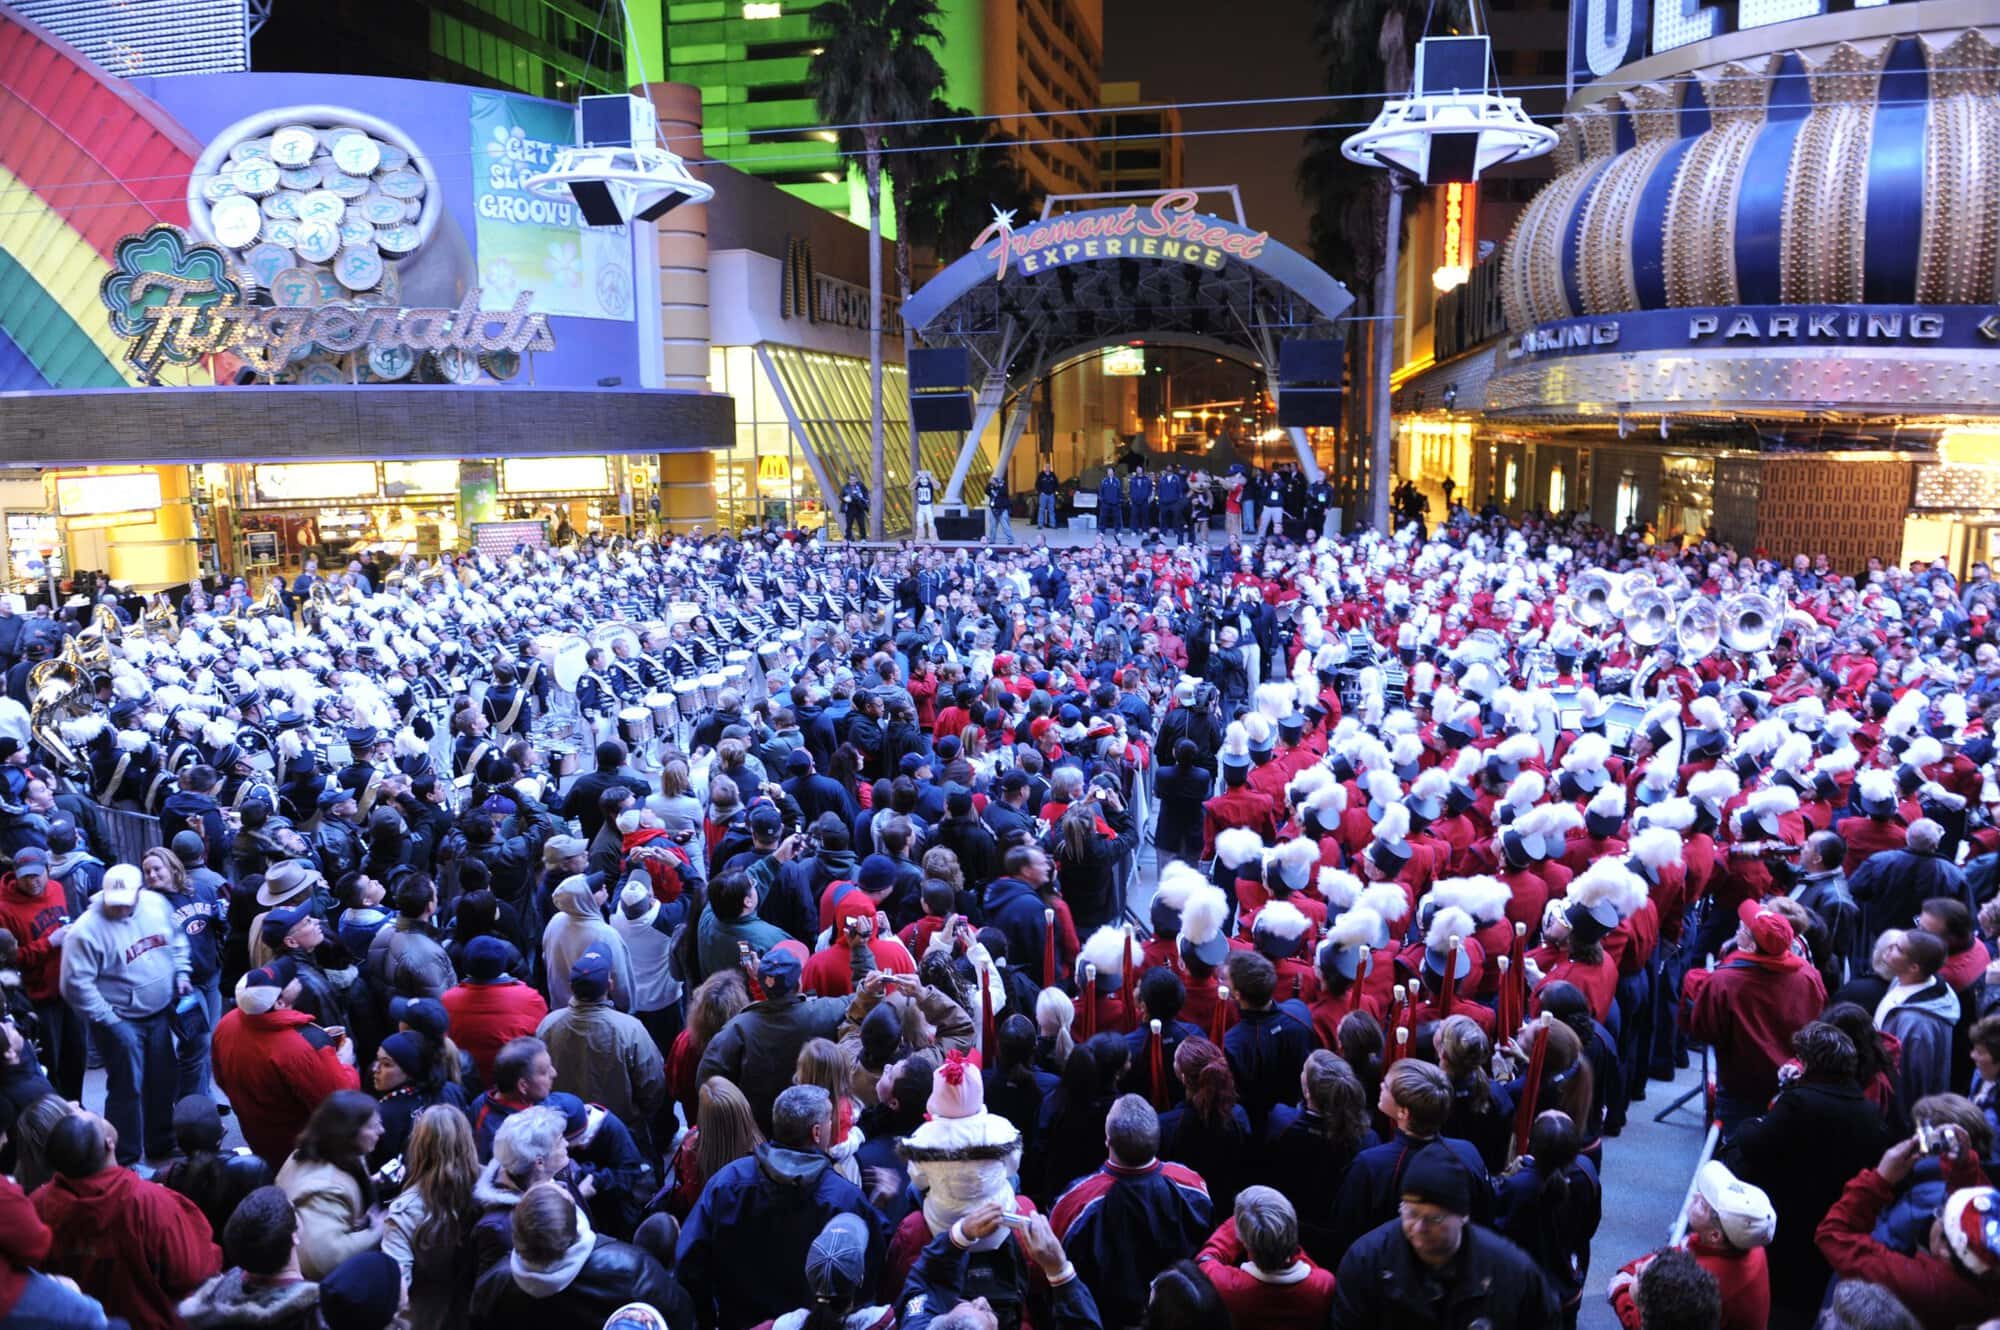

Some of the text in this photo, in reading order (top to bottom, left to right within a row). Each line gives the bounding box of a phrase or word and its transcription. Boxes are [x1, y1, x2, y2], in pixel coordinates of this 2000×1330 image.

[505, 137, 552, 165] GET
[480, 194, 572, 226] GROOVY
[971, 191, 1268, 280] Fremont Street
[1023, 238, 1221, 272] EXPERIENCE
[1689, 313, 1945, 340] PARKING
